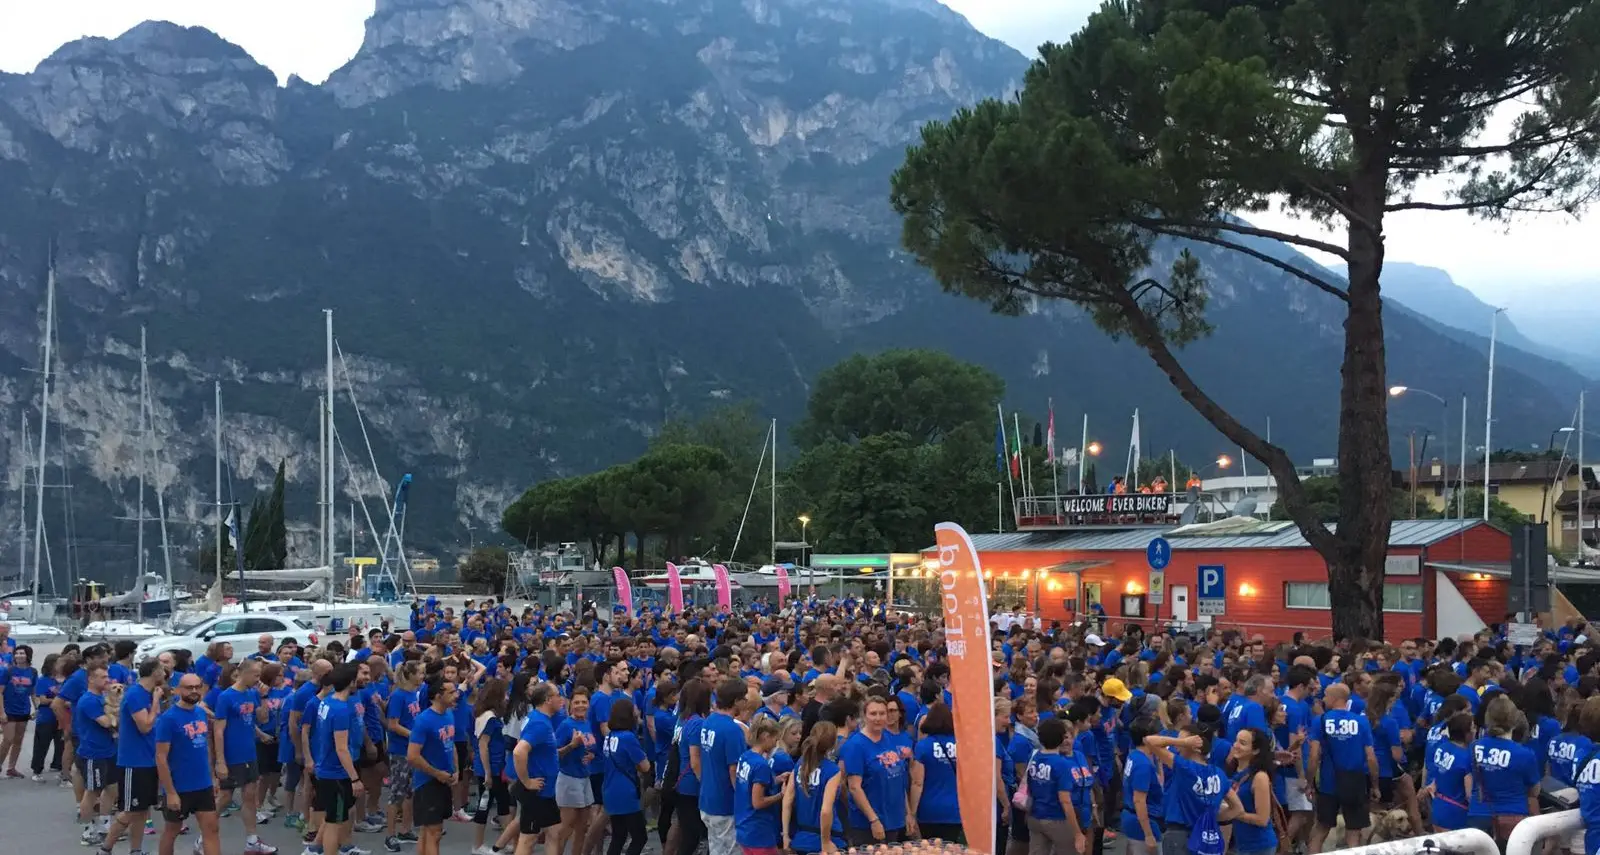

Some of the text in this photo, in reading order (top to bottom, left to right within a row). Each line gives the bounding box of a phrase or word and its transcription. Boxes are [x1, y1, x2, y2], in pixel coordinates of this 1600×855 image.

[1063, 496, 1167, 513] WELCOME 4EVER BIKERS
[1203, 569, 1219, 594] P
[1325, 719, 1359, 735] 5.30
[1474, 744, 1511, 768] 5.30
[1548, 740, 1576, 760] 5.30
[1028, 761, 1052, 780] 5.30
